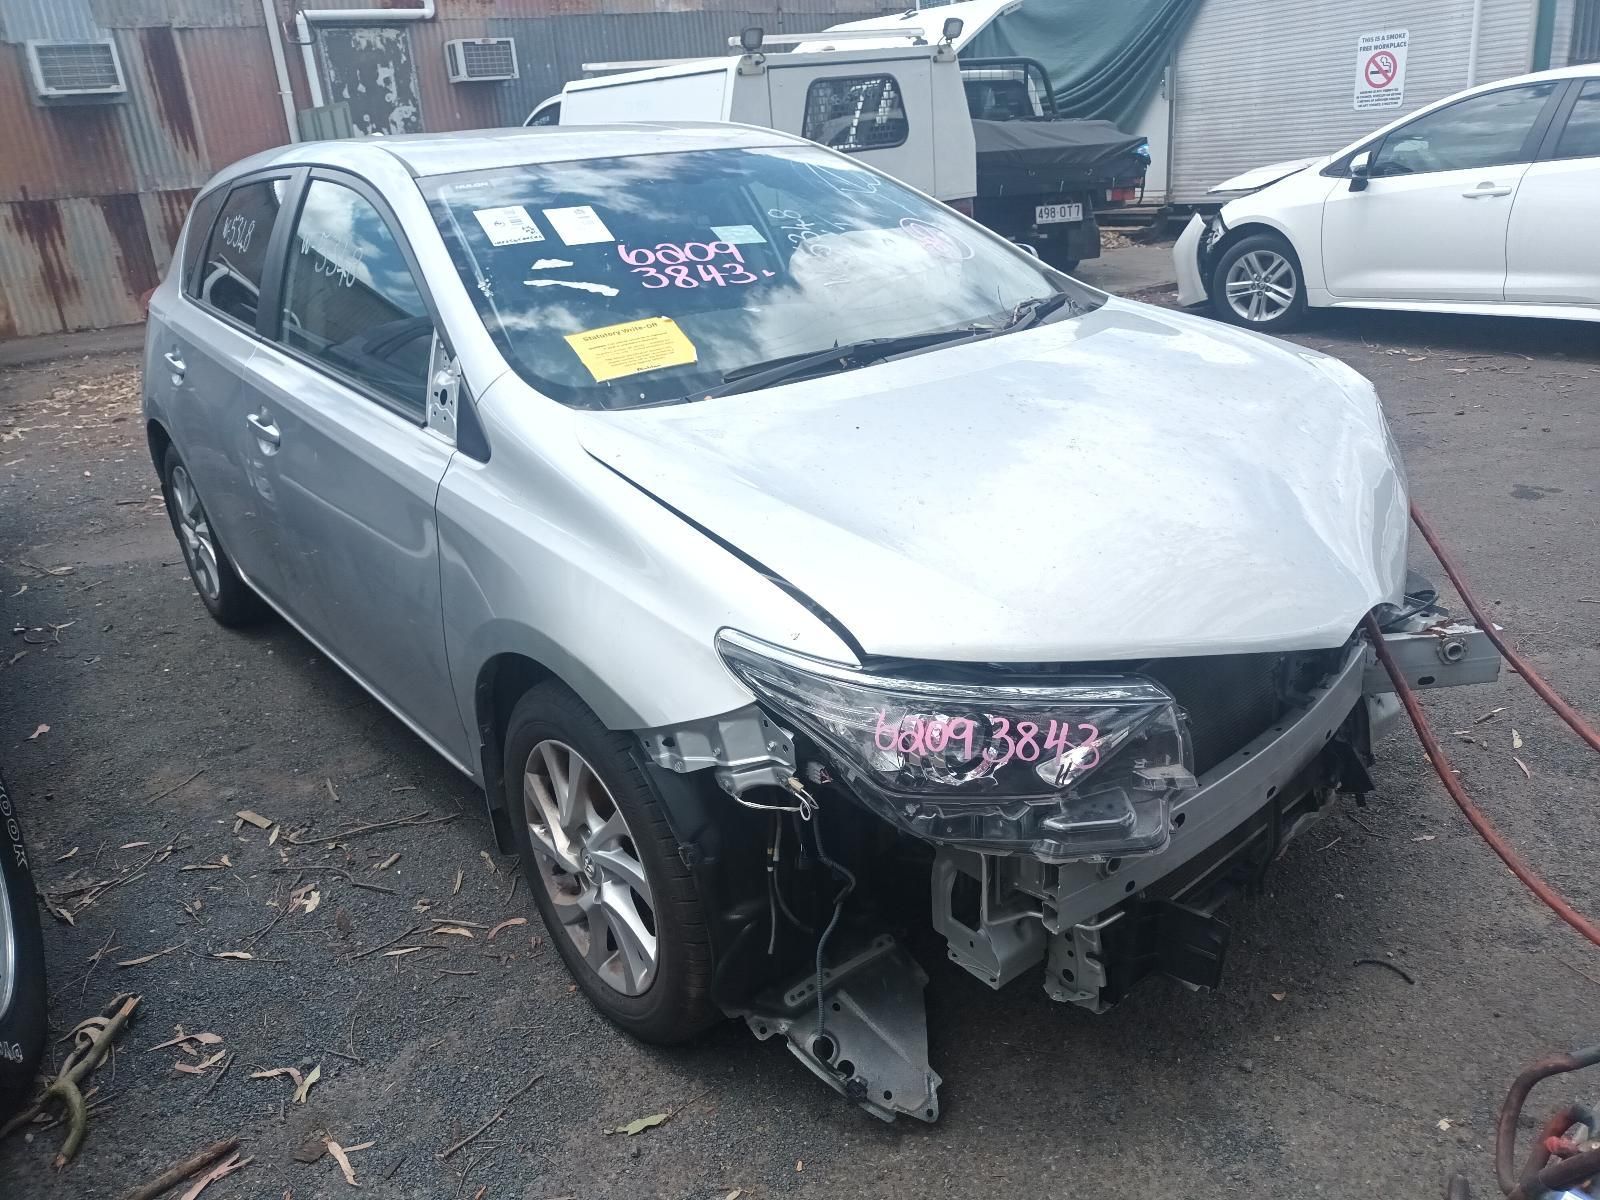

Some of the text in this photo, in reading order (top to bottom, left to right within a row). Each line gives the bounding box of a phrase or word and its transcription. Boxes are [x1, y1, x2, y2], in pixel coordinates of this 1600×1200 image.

[1386, 32, 1406, 40] SMOKE
[1373, 41, 1407, 51] WORKPLACE
[1038, 207, 1056, 219] 498
[582, 329, 621, 343] Statutory
